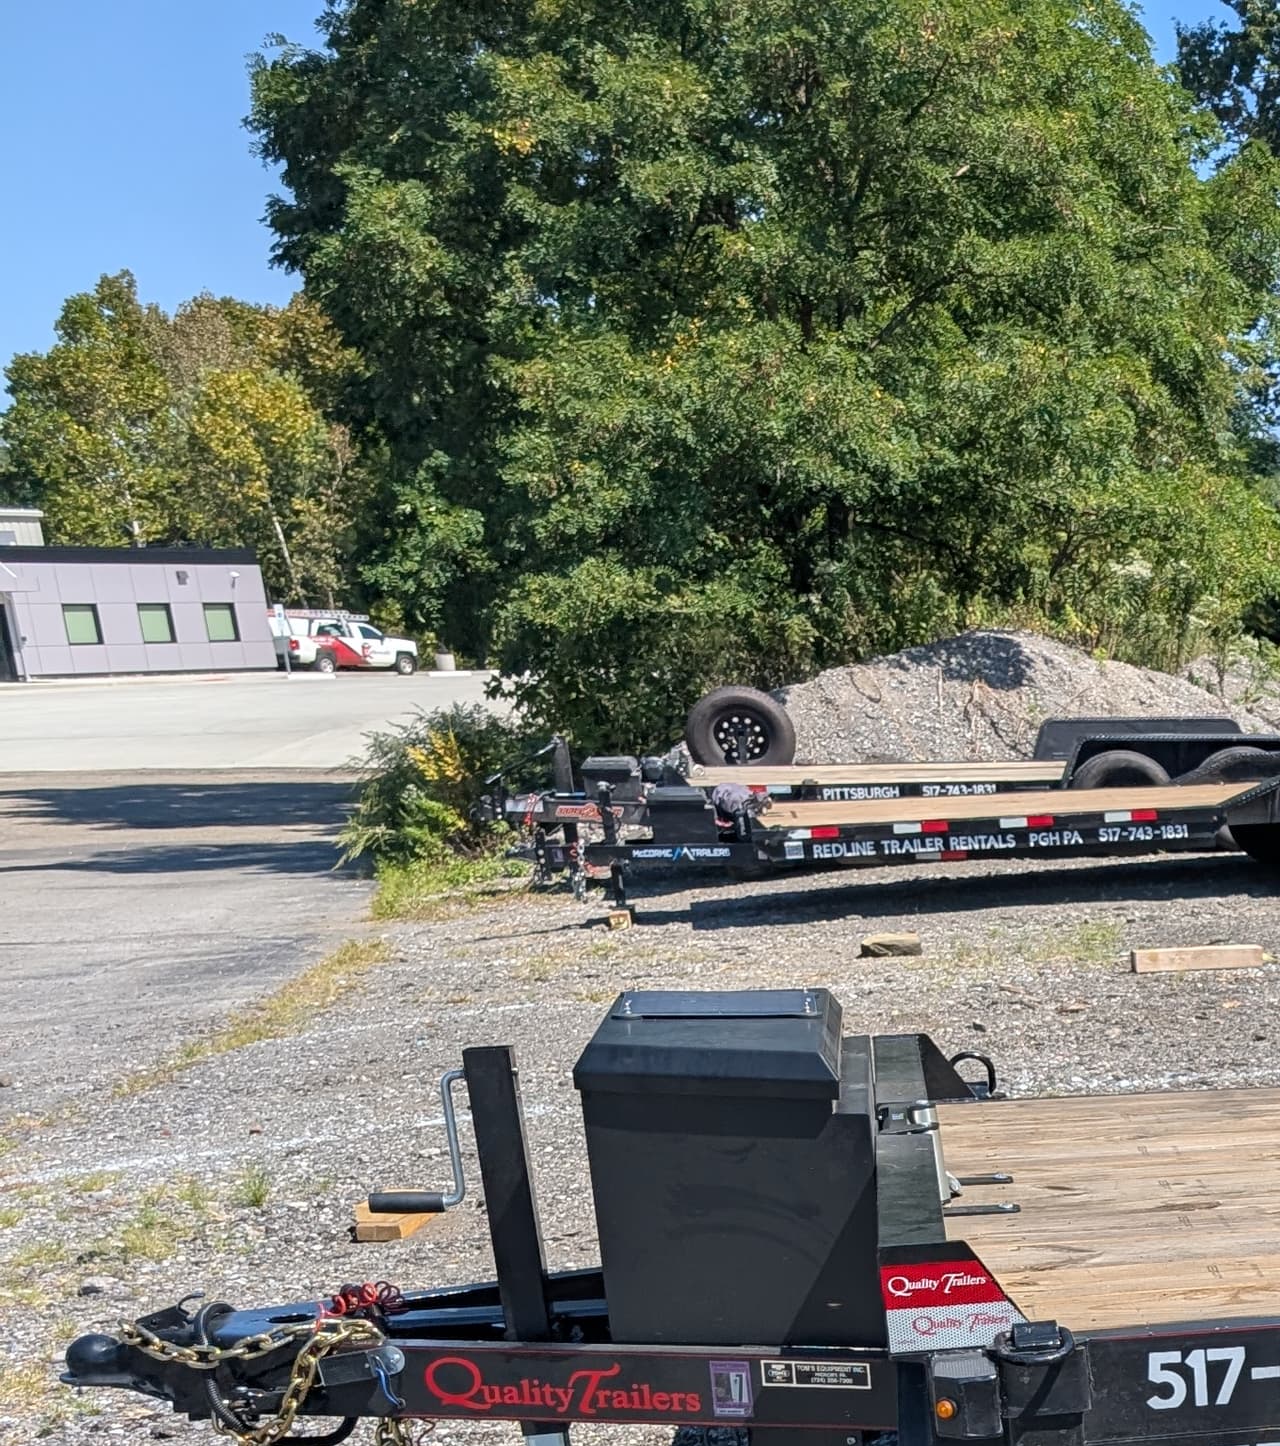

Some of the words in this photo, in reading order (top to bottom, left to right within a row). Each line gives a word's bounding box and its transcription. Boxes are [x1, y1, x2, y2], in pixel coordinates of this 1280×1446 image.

[822, 786, 899, 800] PITTSBURGH
[922, 784, 996, 797] 517-743-1831
[813, 841, 876, 859] REDLINE
[880, 837, 944, 855] TRAILER
[949, 834, 1016, 851] RENTALS
[1029, 831, 1060, 848] PGH
[1061, 829, 1083, 845] PA
[1098, 824, 1189, 842] 517-743-1831
[888, 1276, 940, 1297] Quality
[941, 1272, 987, 1294] Trailers
[912, 1315, 963, 1336] Quality
[424, 1357, 575, 1413] Quality
[568, 1362, 701, 1414] Trailers
